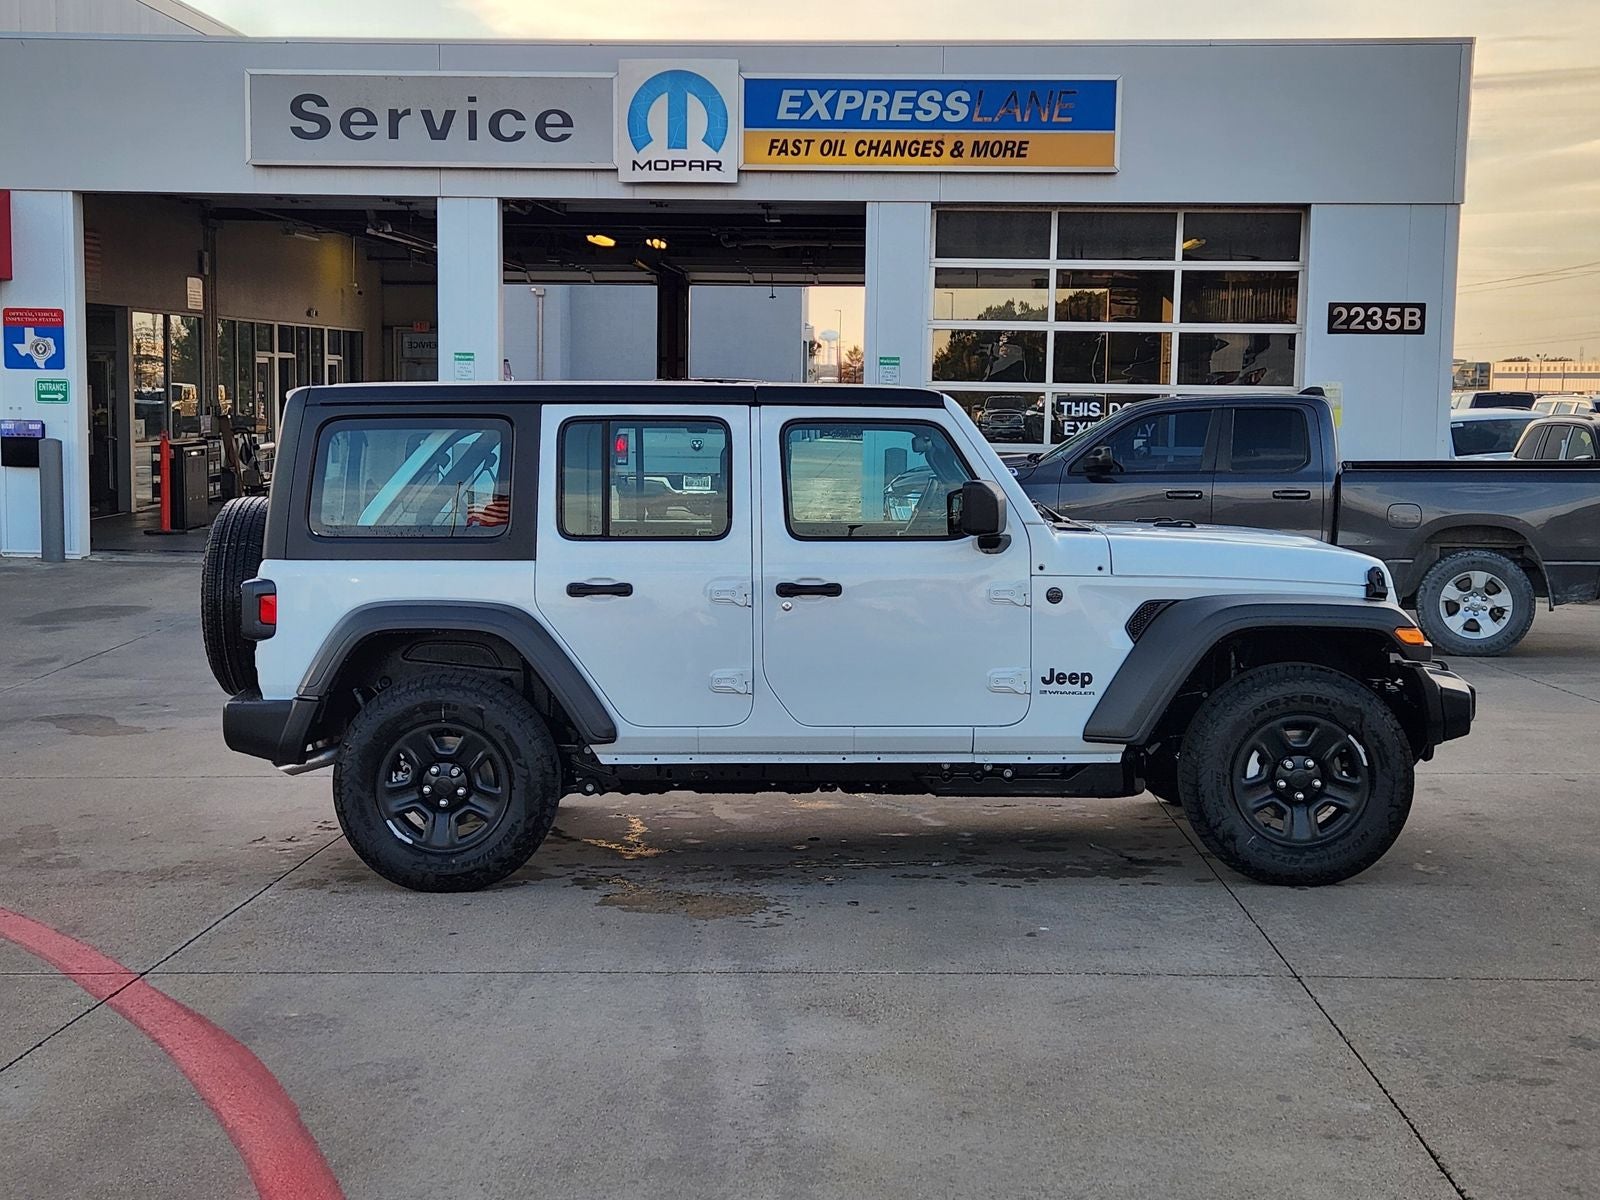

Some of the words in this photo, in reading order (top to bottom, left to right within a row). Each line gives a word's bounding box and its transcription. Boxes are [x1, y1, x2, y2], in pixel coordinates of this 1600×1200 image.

[289, 93, 574, 143] Service
[767, 138, 816, 158] FAST
[819, 138, 848, 158] OIL
[854, 138, 945, 159] CHANGES
[949, 138, 965, 159] &
[970, 139, 1030, 159] MORE
[631, 159, 723, 173] MOPAR
[1332, 306, 1421, 331] 2235B
[38, 383, 66, 391] ENTRANCE
[1060, 401, 1101, 417] THIS
[1040, 667, 1093, 689] Jeep
